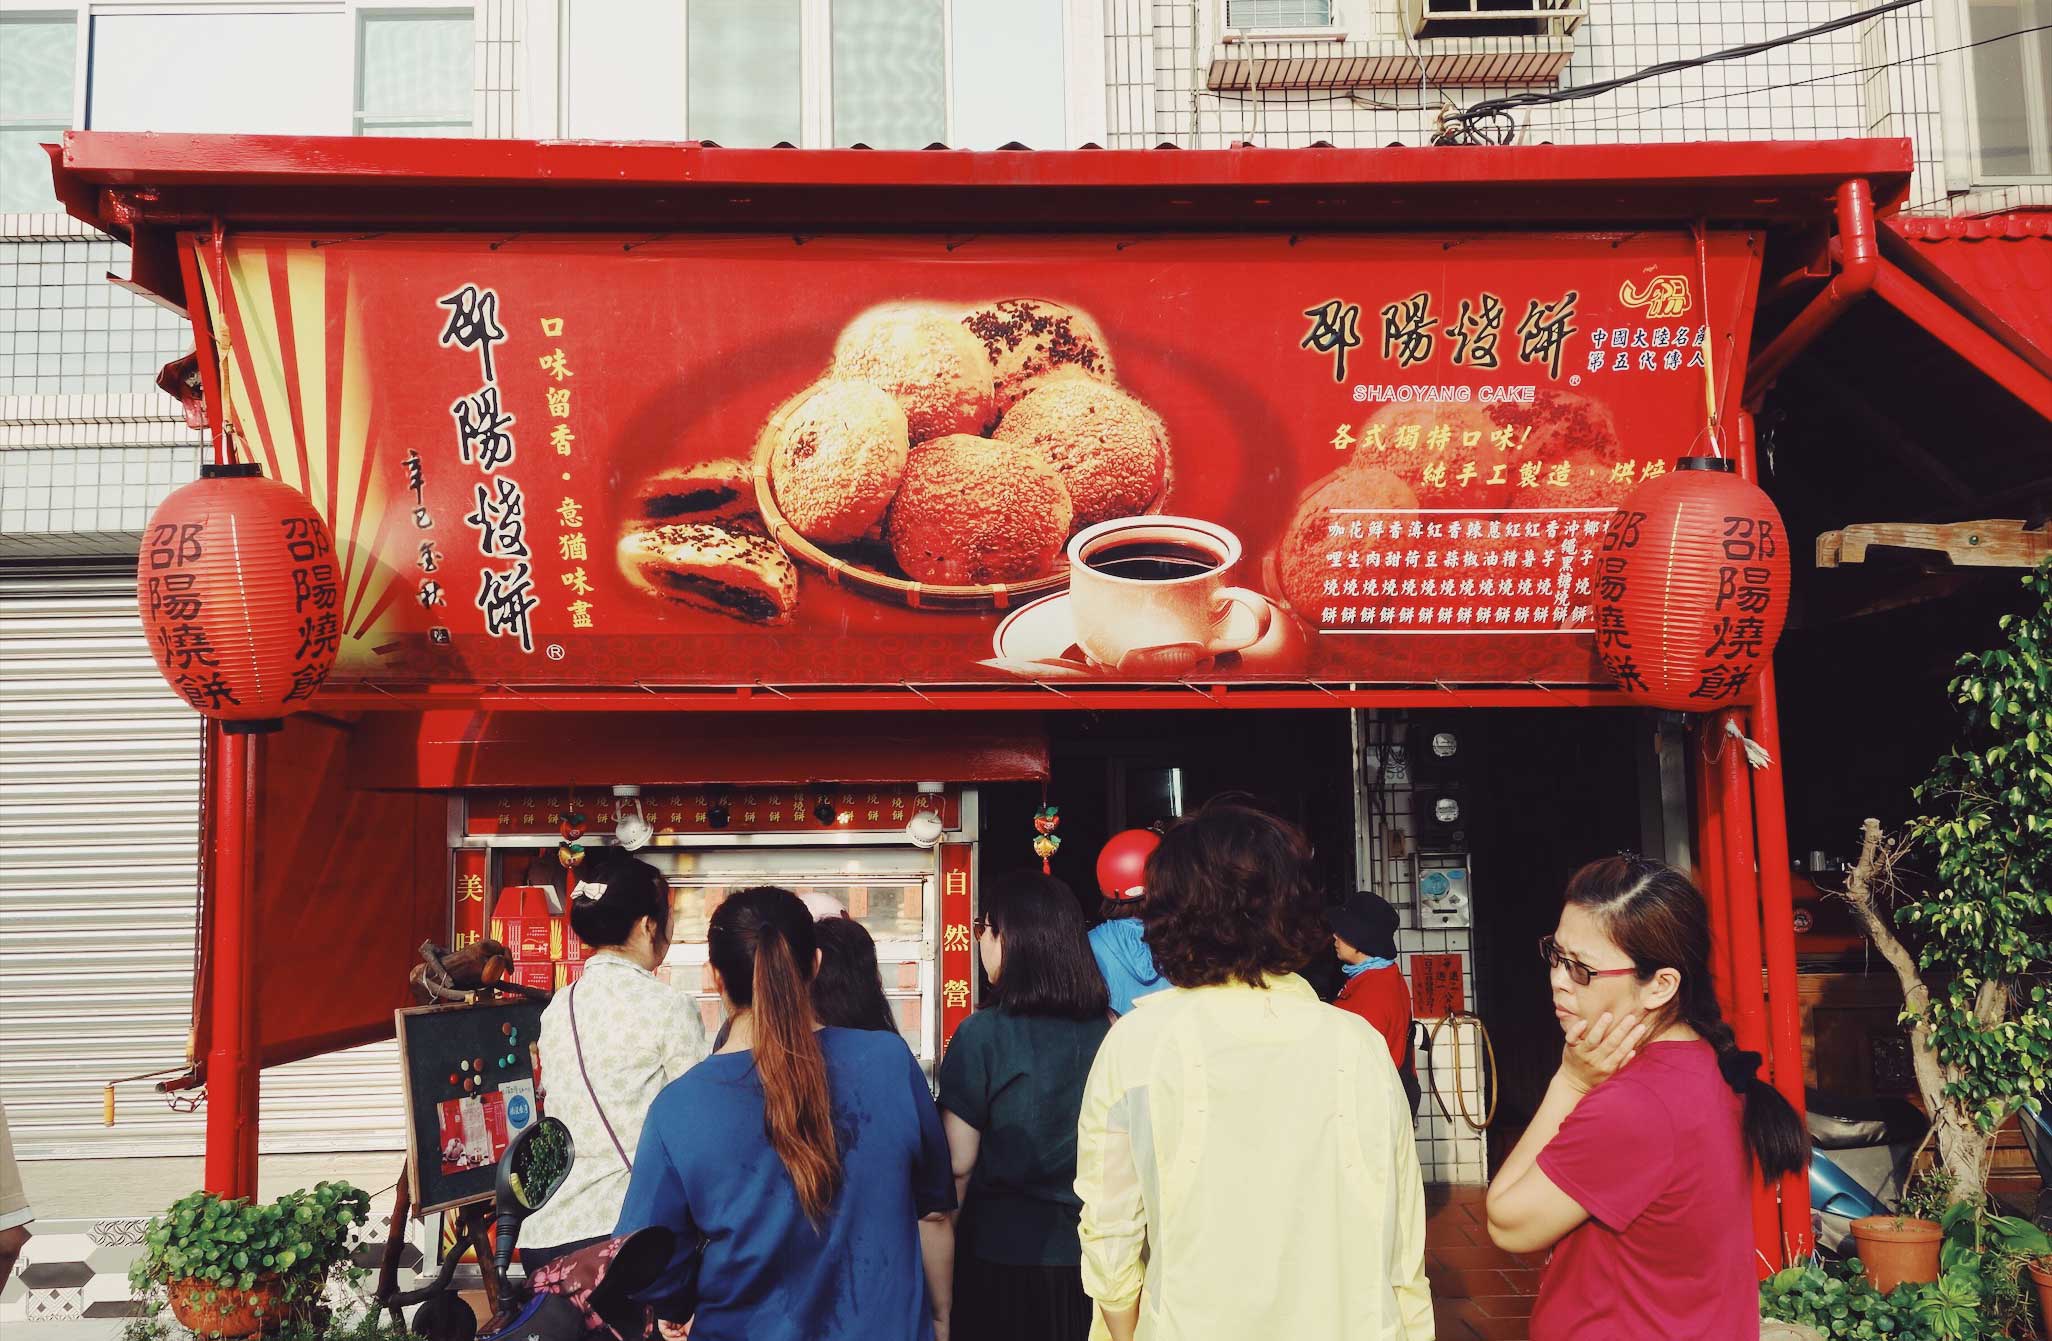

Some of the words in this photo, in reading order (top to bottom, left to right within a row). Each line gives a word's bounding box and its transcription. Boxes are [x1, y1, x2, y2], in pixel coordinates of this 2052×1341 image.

[1301, 291, 1579, 382] 邵陽燒餅
[1352, 385, 1471, 402] SHAOYANG
[1478, 386, 1536, 402] CAKE
[1587, 350, 1705, 372] 第五代傳人
[438, 284, 538, 651] 邵陽燒餅
[150, 523, 241, 711] 邵陽燒餅
[280, 516, 338, 703] 邵陽燒餅
[1594, 510, 1649, 692] 邵陽燒餅
[1689, 516, 1776, 700] 邵陽燒餅
[943, 868, 970, 1053] 自然營
